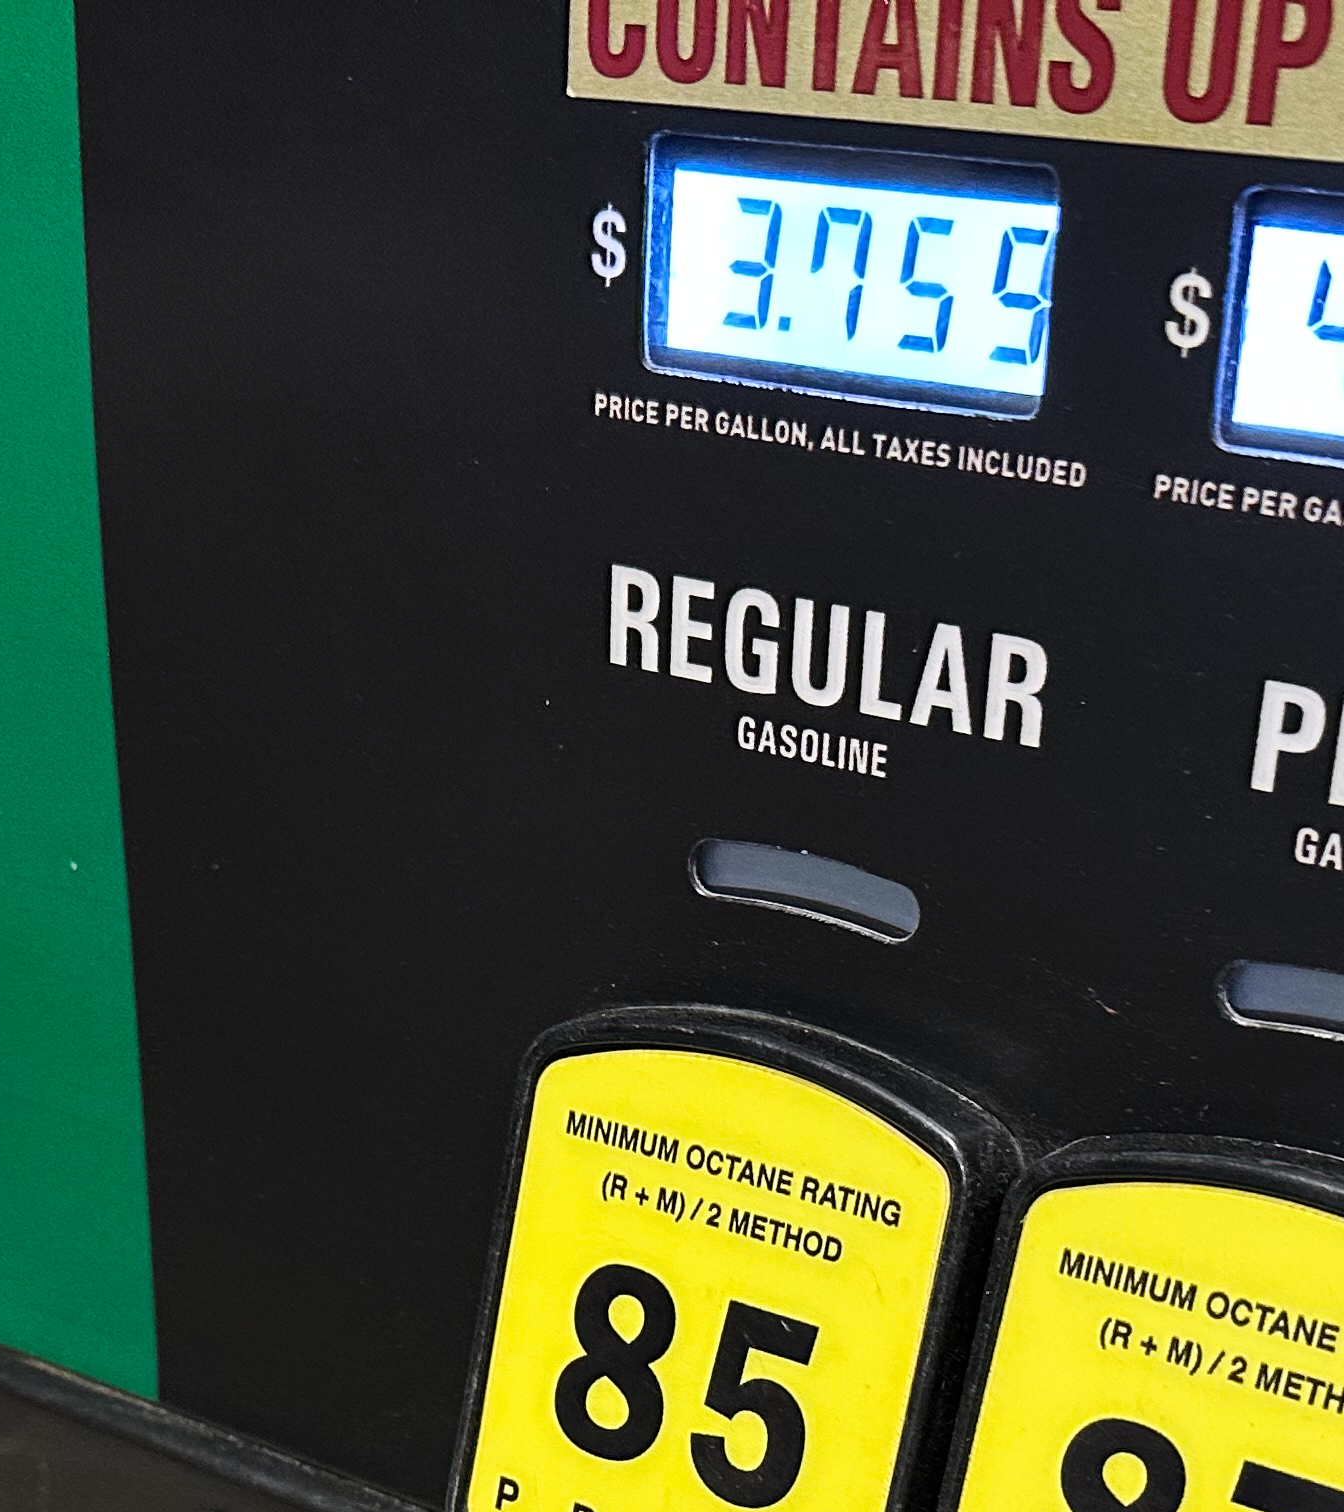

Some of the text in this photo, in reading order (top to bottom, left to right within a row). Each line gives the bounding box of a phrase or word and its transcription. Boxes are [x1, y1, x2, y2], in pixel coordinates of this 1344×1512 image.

[587, 0, 1121, 114] CONTAINS
[1163, 0, 1333, 126] UP
[590, 202, 627, 287] $
[723, 196, 1054, 365] 3.759
[1163, 267, 1213, 359] $
[593, 392, 1087, 488] PRICE PER GALLON, ALL TAXES INCLUDED
[1153, 473, 1235, 512] PRICE
[1241, 485, 1296, 520] PER
[609, 563, 1050, 748] REGULAR
[737, 715, 888, 779] GASOLINE
[566, 1109, 902, 1228] MINIMUM OCTANE RATING
[601, 1171, 629, 1201] (R
[656, 1187, 686, 1223] M)
[705, 1202, 721, 1228] 2
[728, 1207, 843, 1263] METHOD
[1058, 1248, 1198, 1313] MINIMUM
[1206, 1291, 1341, 1353] OCTANE
[554, 1262, 820, 1510] 85
[1099, 1317, 1133, 1351] (R
[1166, 1336, 1203, 1376] M)
[1227, 1356, 1248, 1384] 2
